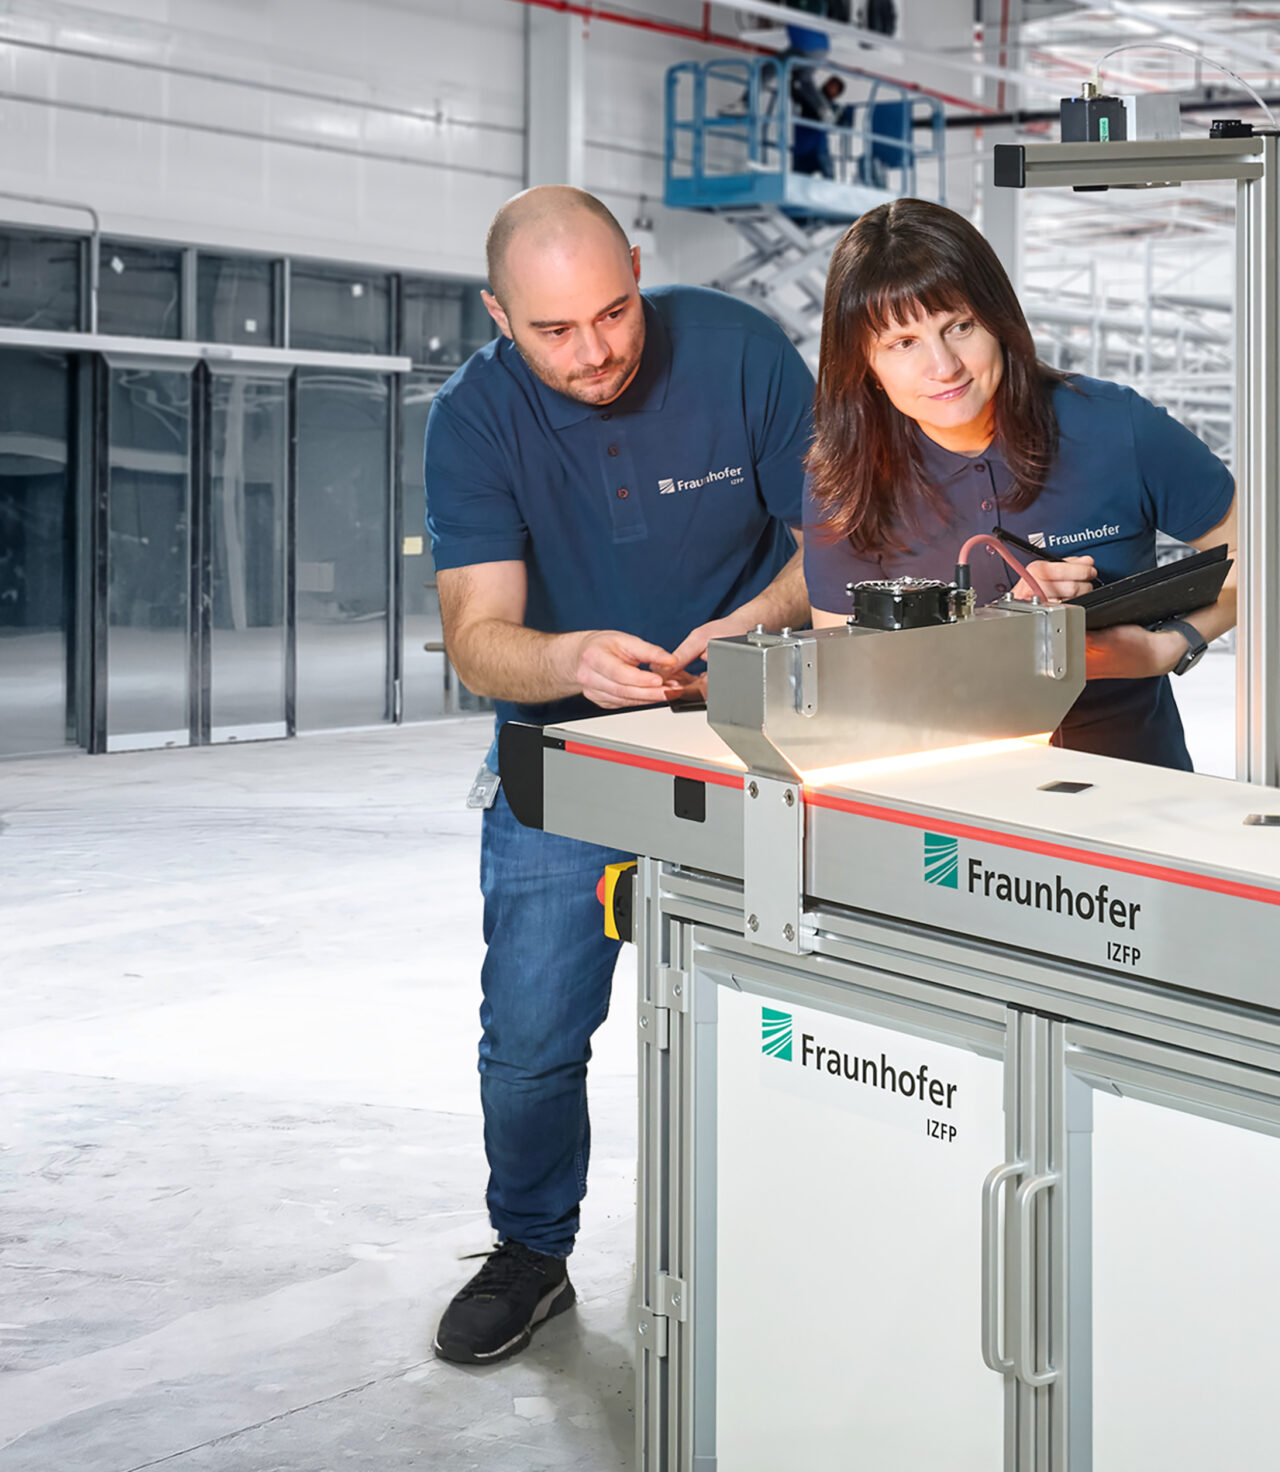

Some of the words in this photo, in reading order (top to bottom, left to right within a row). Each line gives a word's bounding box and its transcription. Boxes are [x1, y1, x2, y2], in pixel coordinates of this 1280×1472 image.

[1048, 524, 1120, 547] Fraunhofer
[968, 858, 1141, 930] Fraunhofer
[1107, 941, 1141, 966] IZFP
[802, 1033, 957, 1109] Fraunhofer
[926, 1118, 957, 1143] IZFP
